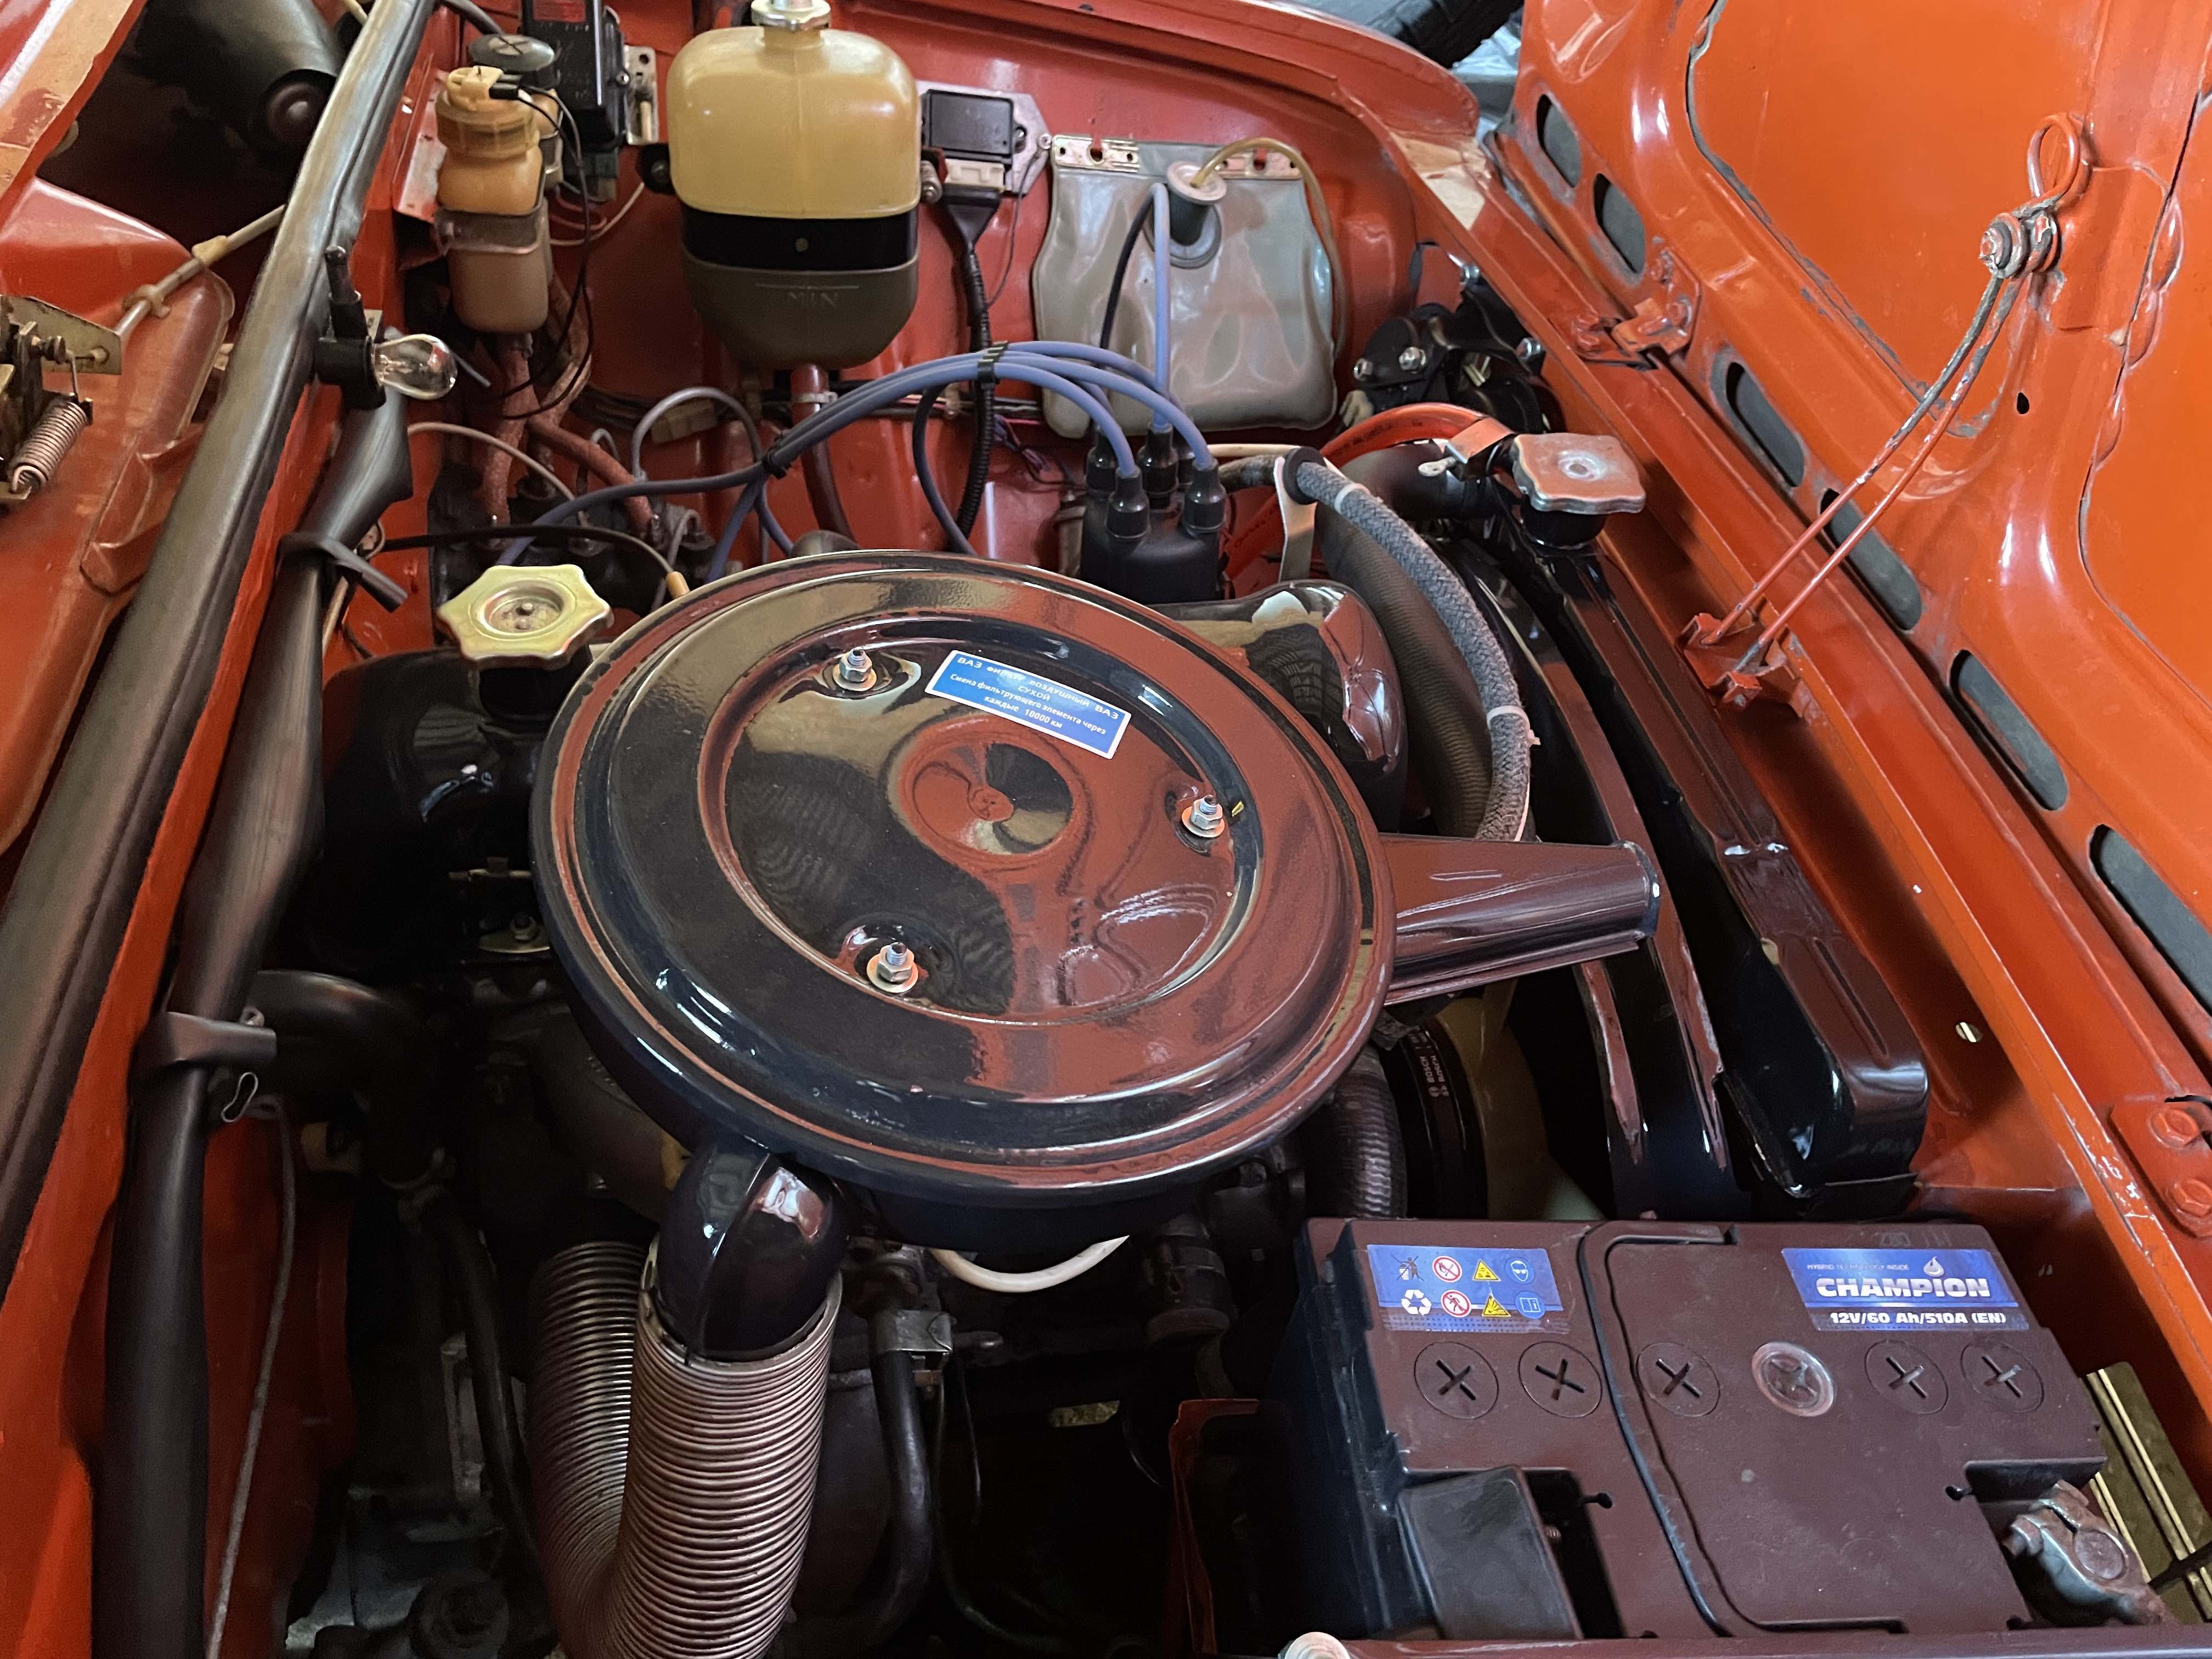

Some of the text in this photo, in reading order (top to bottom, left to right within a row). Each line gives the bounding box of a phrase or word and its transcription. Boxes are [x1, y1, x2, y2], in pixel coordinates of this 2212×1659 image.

[957, 657, 983, 668] ВАЗ
[1094, 704, 1119, 719] ВАЗ
[950, 674, 1106, 735] Смена фильтрующего элемента через
[984, 696, 1063, 729] каждые 10000 км
[1419, 1056, 1435, 1083] BOSCH
[1816, 1278, 1991, 1297] CHAMPION
[1830, 1312, 2006, 1325] 12V/60 Ah/510A (EN)
